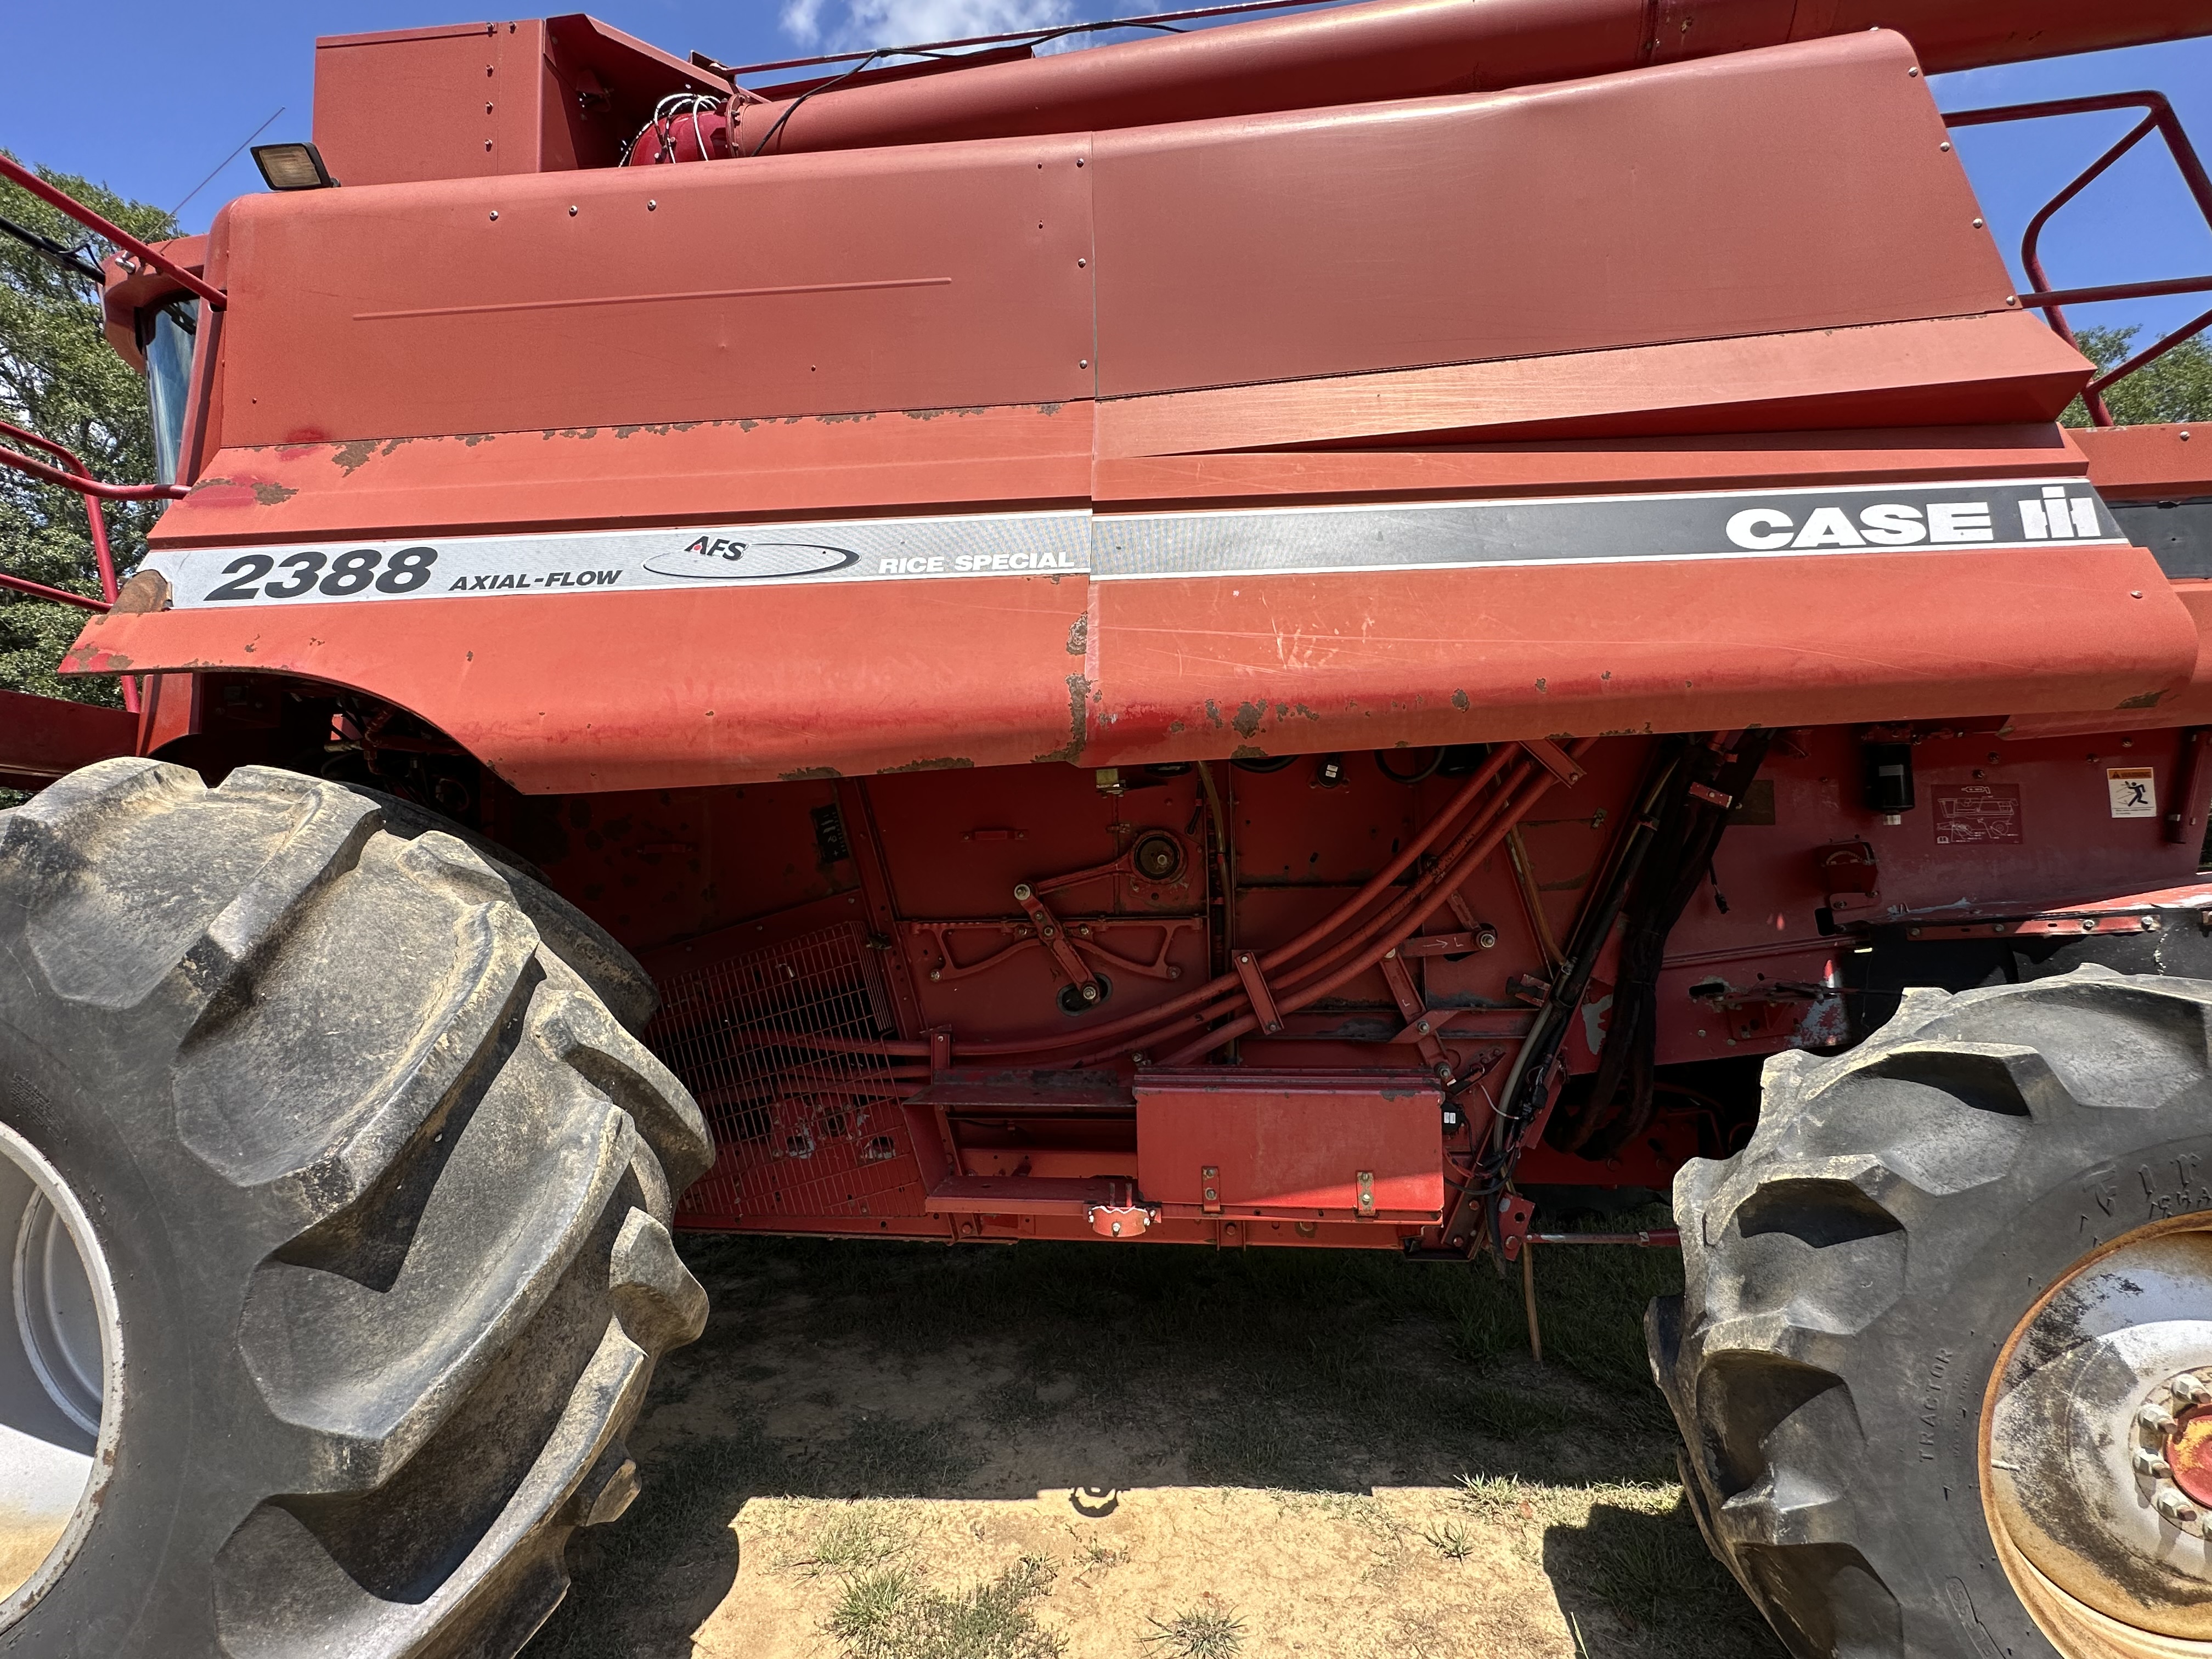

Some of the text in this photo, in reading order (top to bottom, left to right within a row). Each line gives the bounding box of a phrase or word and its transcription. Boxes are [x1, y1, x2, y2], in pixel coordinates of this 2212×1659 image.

[1726, 503, 1994, 550] CASE
[684, 535, 747, 561] AFS
[878, 550, 1075, 574] RICE SPECIAL
[204, 546, 438, 601] 2388
[448, 570, 623, 591] AXIAL-FLOW
[1918, 1347, 1953, 1463] TRACTOR
